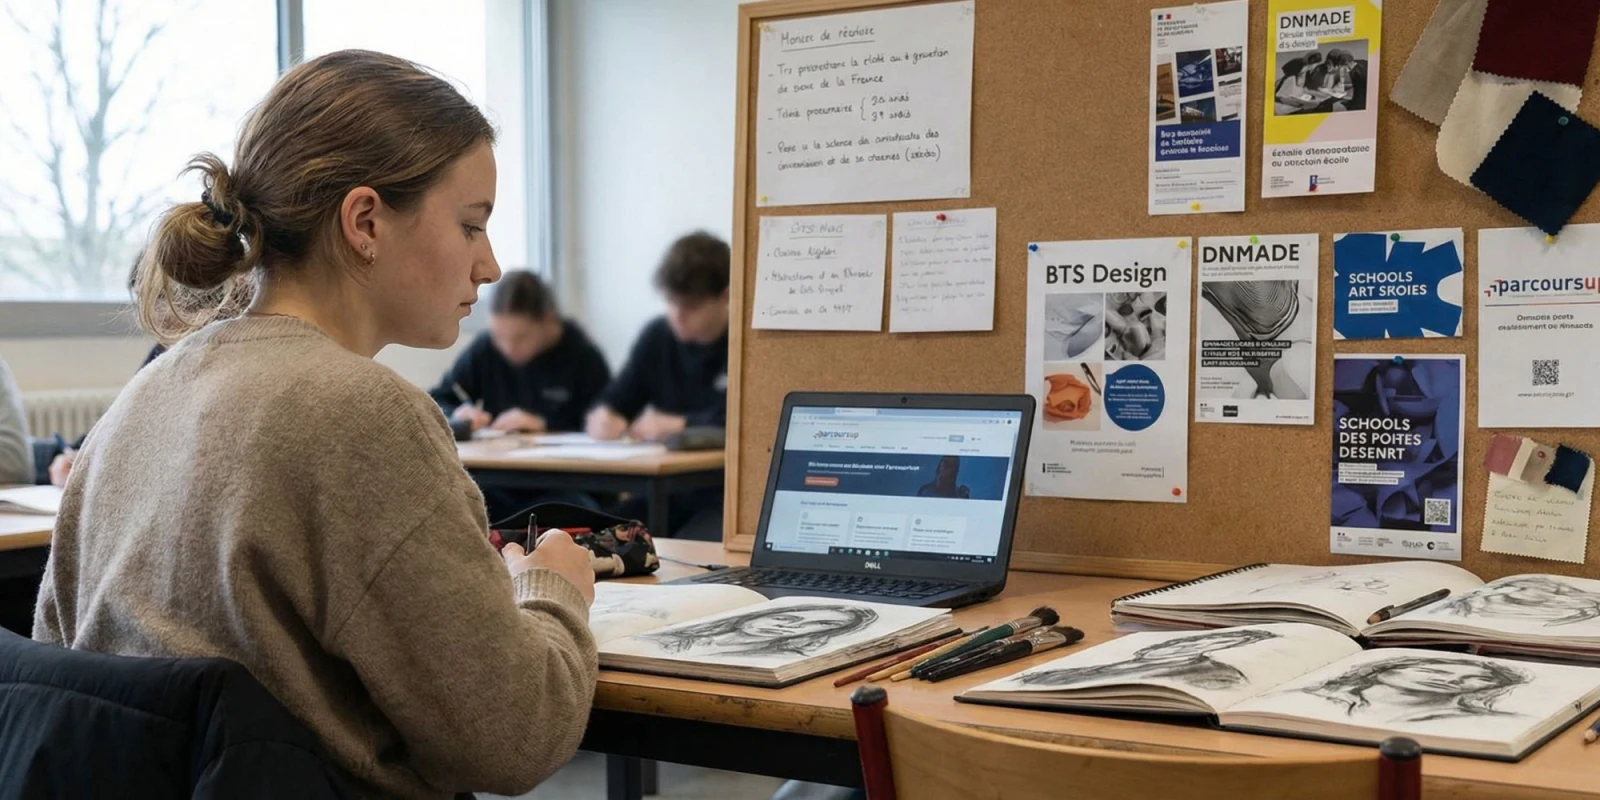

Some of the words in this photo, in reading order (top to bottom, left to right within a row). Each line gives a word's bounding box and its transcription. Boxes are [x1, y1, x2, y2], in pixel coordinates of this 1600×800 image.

[1280, 10, 1351, 29] DNMADE
[1203, 243, 1300, 263] DNMADE
[1046, 265, 1085, 284] BTS
[1092, 262, 1167, 288] Design
[1349, 271, 1413, 284] SCHOOLS
[1348, 286, 1375, 297] ART
[1499, 277, 1600, 297] parcoursu
[1339, 417, 1411, 431] SCHOOLS
[1340, 431, 1367, 445] DES
[1339, 446, 1406, 460] DESENRT
[864, 561, 882, 570] DELL
